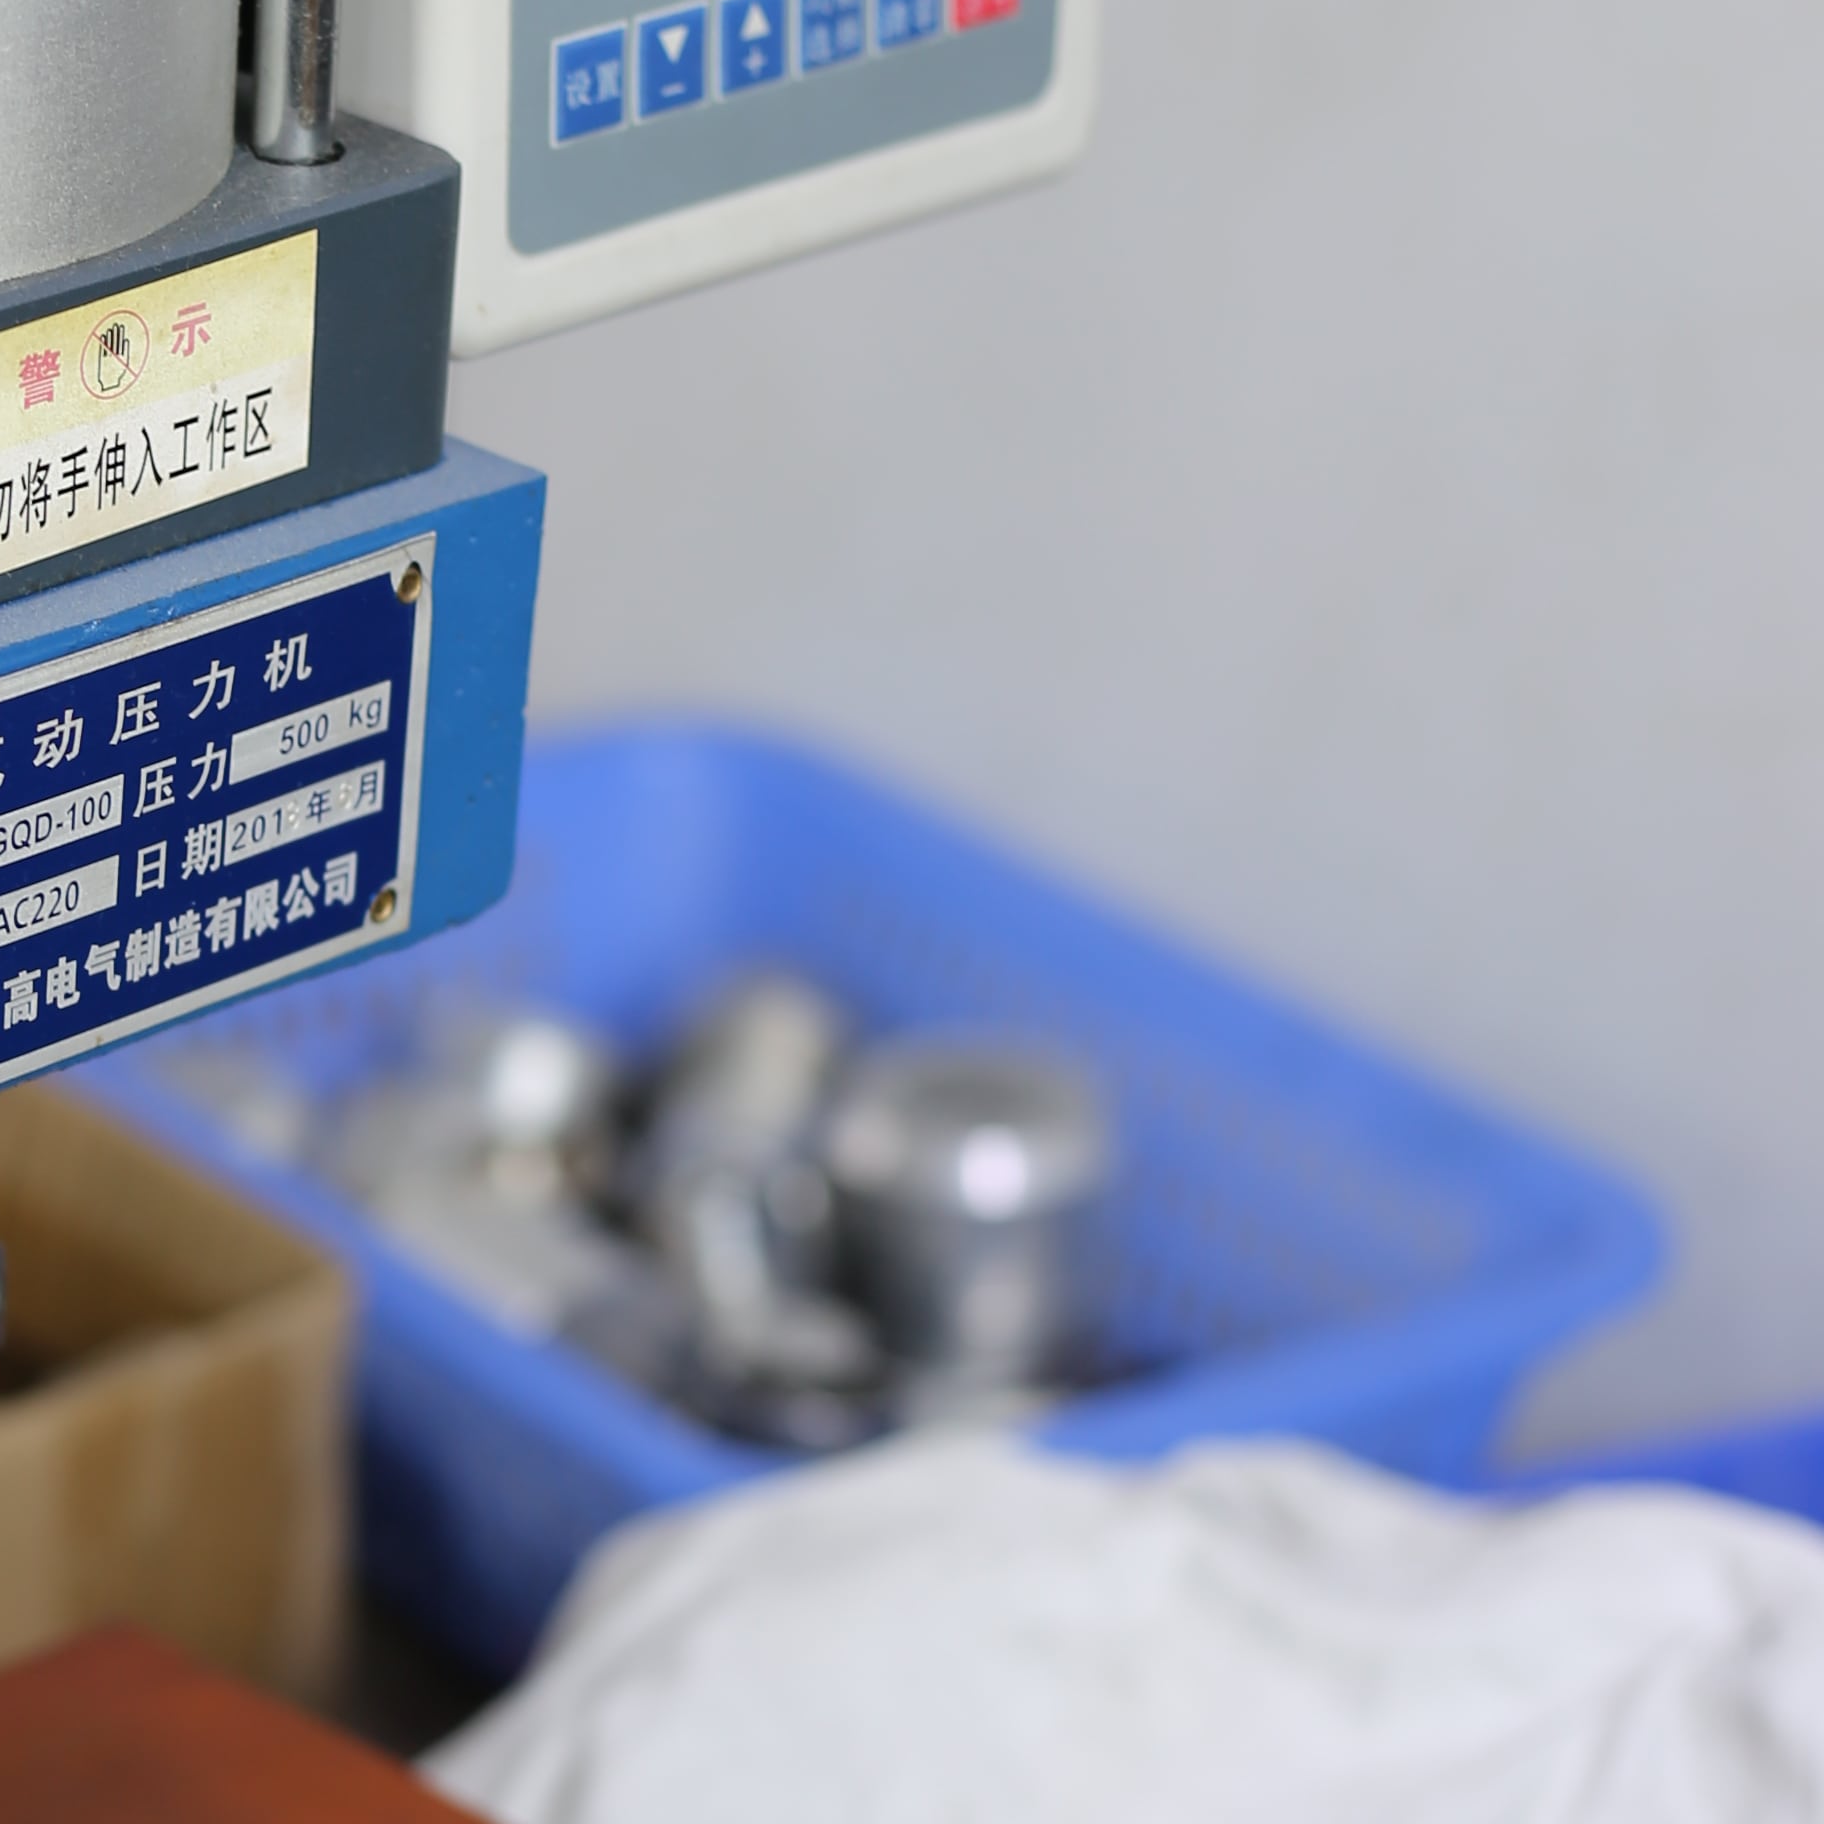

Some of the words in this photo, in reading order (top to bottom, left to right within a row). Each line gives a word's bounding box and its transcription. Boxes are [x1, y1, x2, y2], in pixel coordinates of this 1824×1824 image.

[132, 741, 228, 819] 压力
[279, 713, 330, 756] 500
[348, 697, 383, 730] kg
[134, 820, 224, 898] 日期
